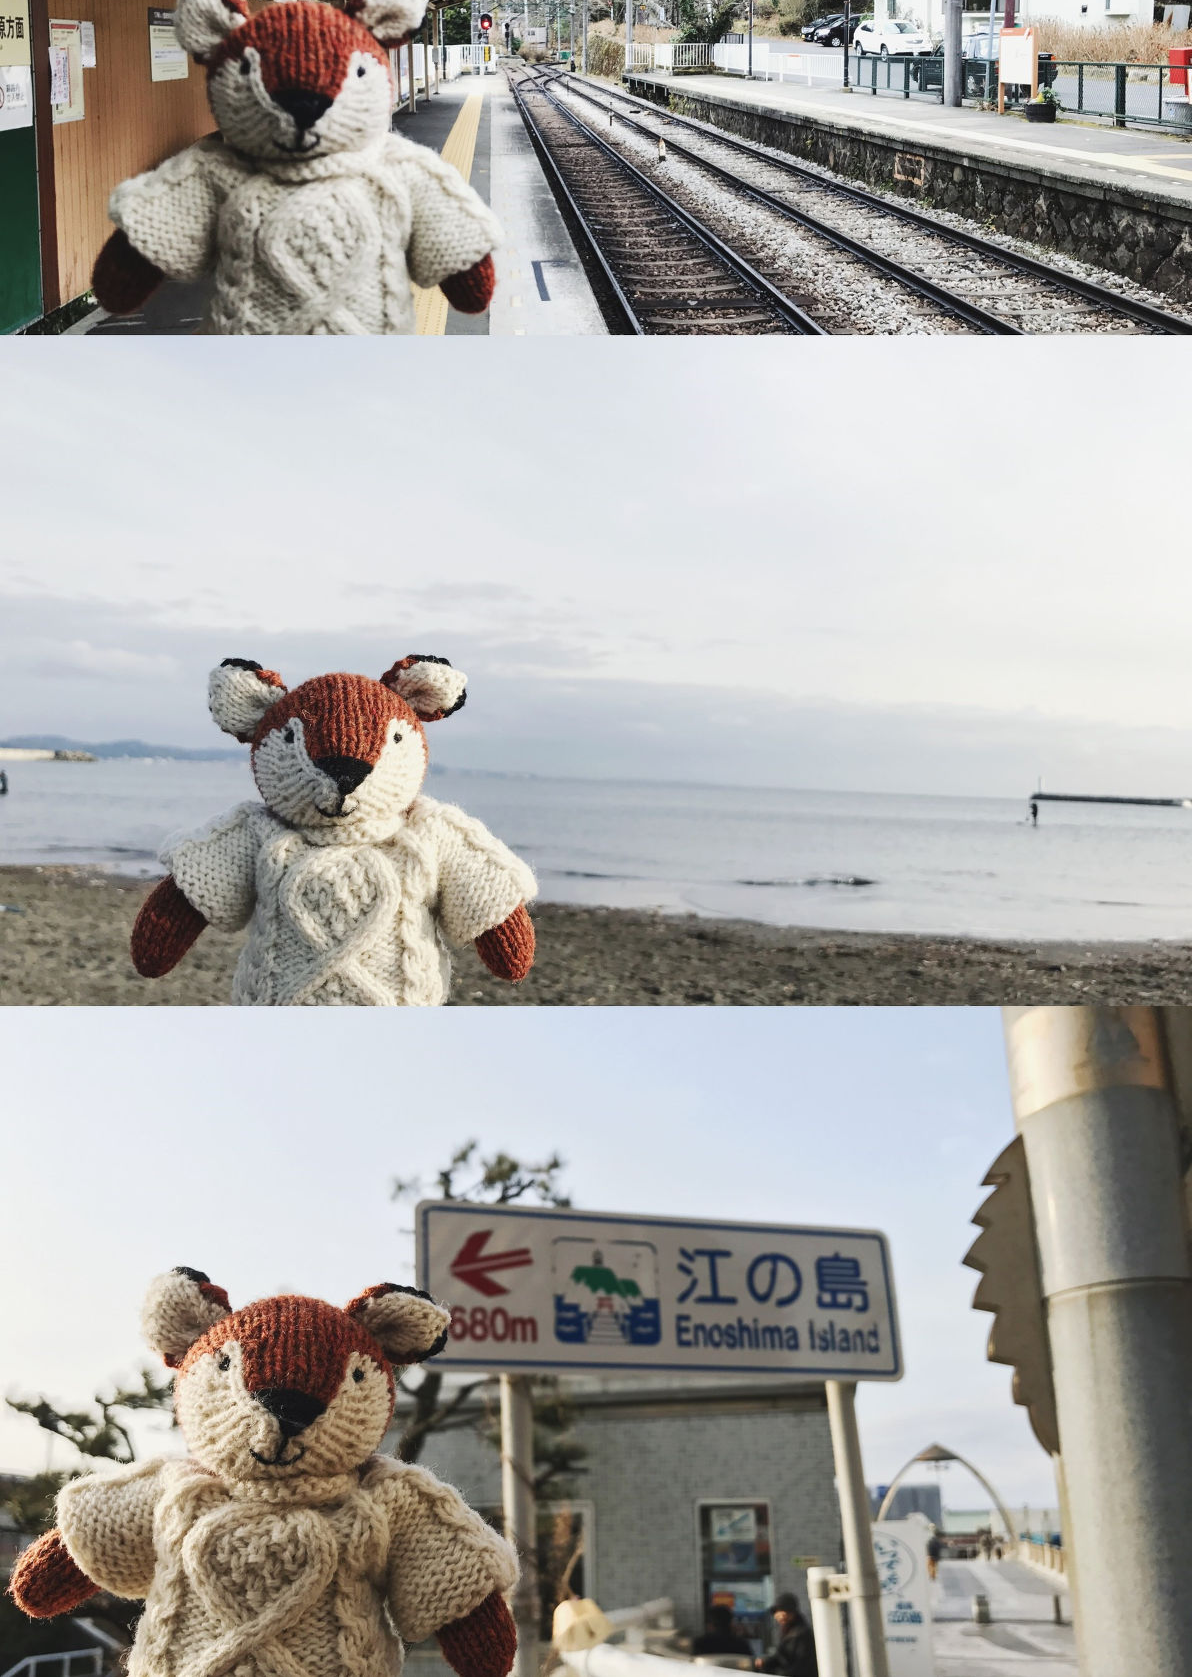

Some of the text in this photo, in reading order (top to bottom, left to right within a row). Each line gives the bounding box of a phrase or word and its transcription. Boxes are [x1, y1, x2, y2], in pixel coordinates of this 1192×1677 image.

[677, 1247, 869, 1312] 江の島
[449, 1306, 538, 1343] 680m
[676, 1314, 881, 1354] Enoshima Island
